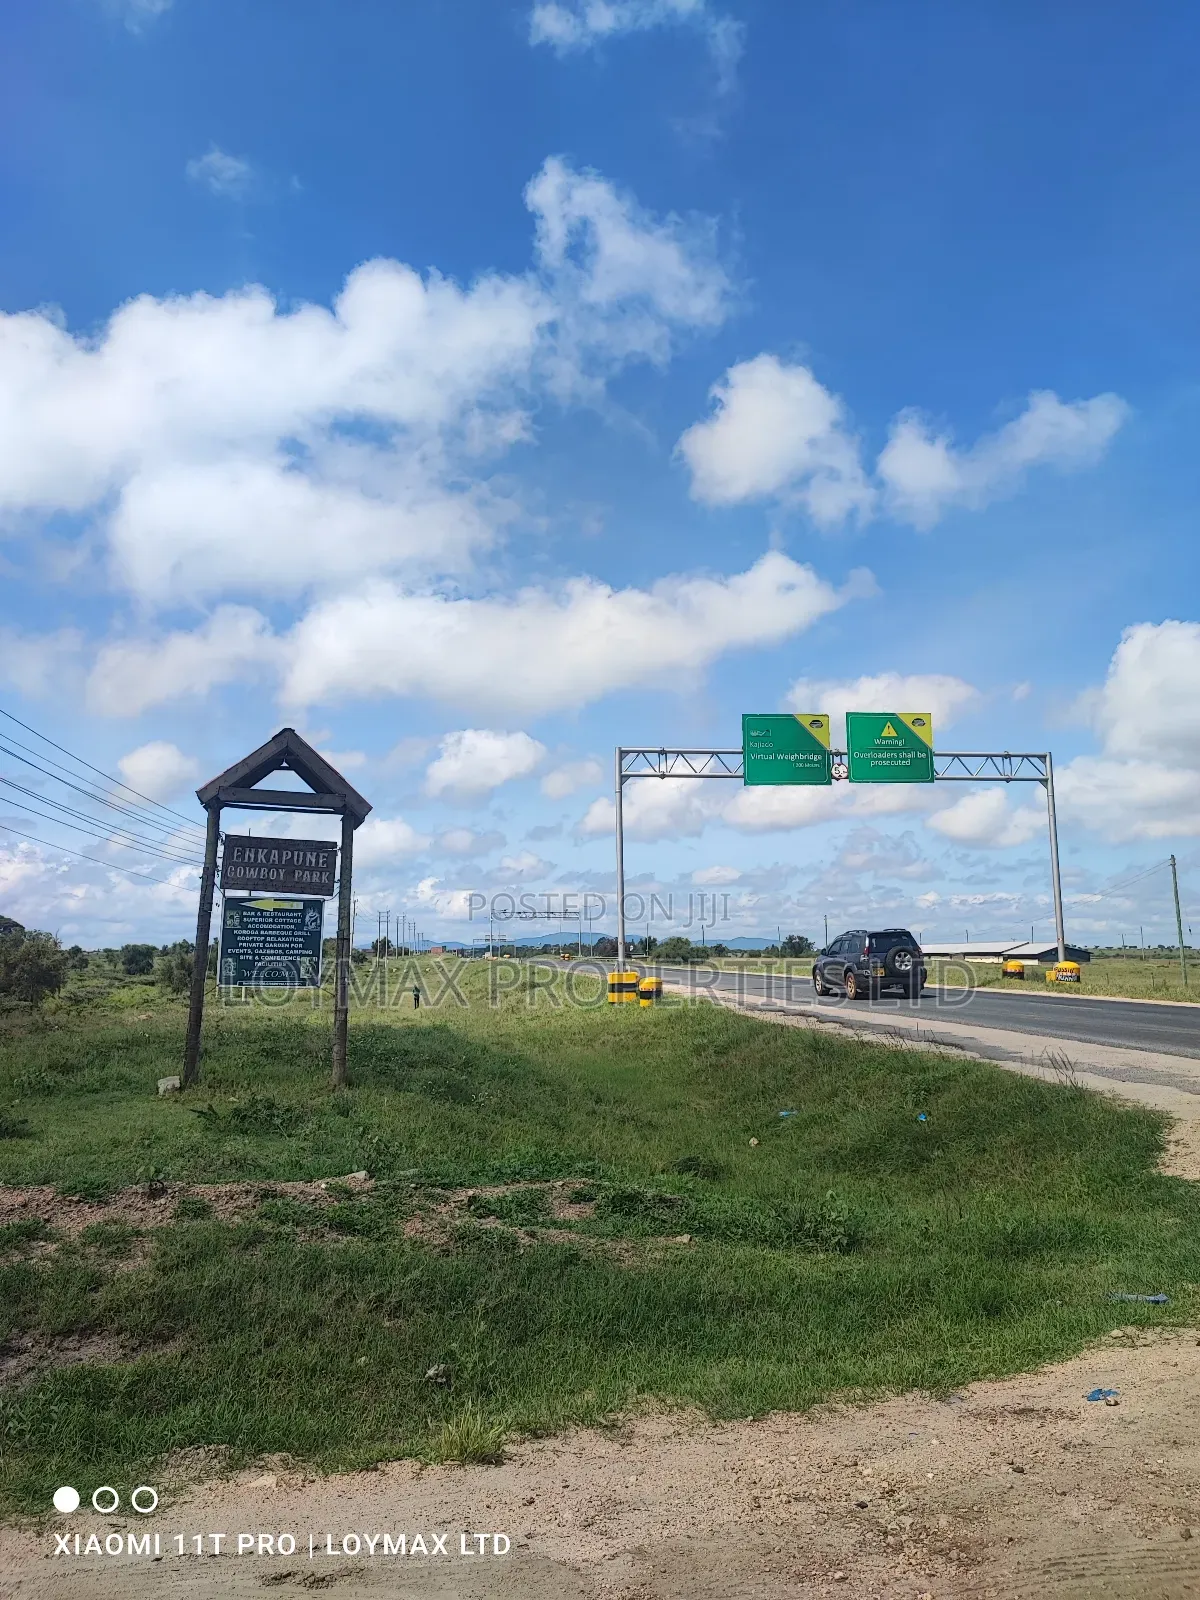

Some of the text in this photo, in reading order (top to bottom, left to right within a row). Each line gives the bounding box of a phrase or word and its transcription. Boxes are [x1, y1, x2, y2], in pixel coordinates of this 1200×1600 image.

[874, 738, 905, 746] Warning!
[776, 753, 823, 762] Weighbridge
[853, 751, 898, 759] Overloaders
[899, 751, 916, 759] shall
[870, 759, 911, 767] prosecuted
[232, 847, 328, 868] ENKAPUNE
[294, 869, 330, 884] PARK
[241, 969, 297, 978] WELCOME
